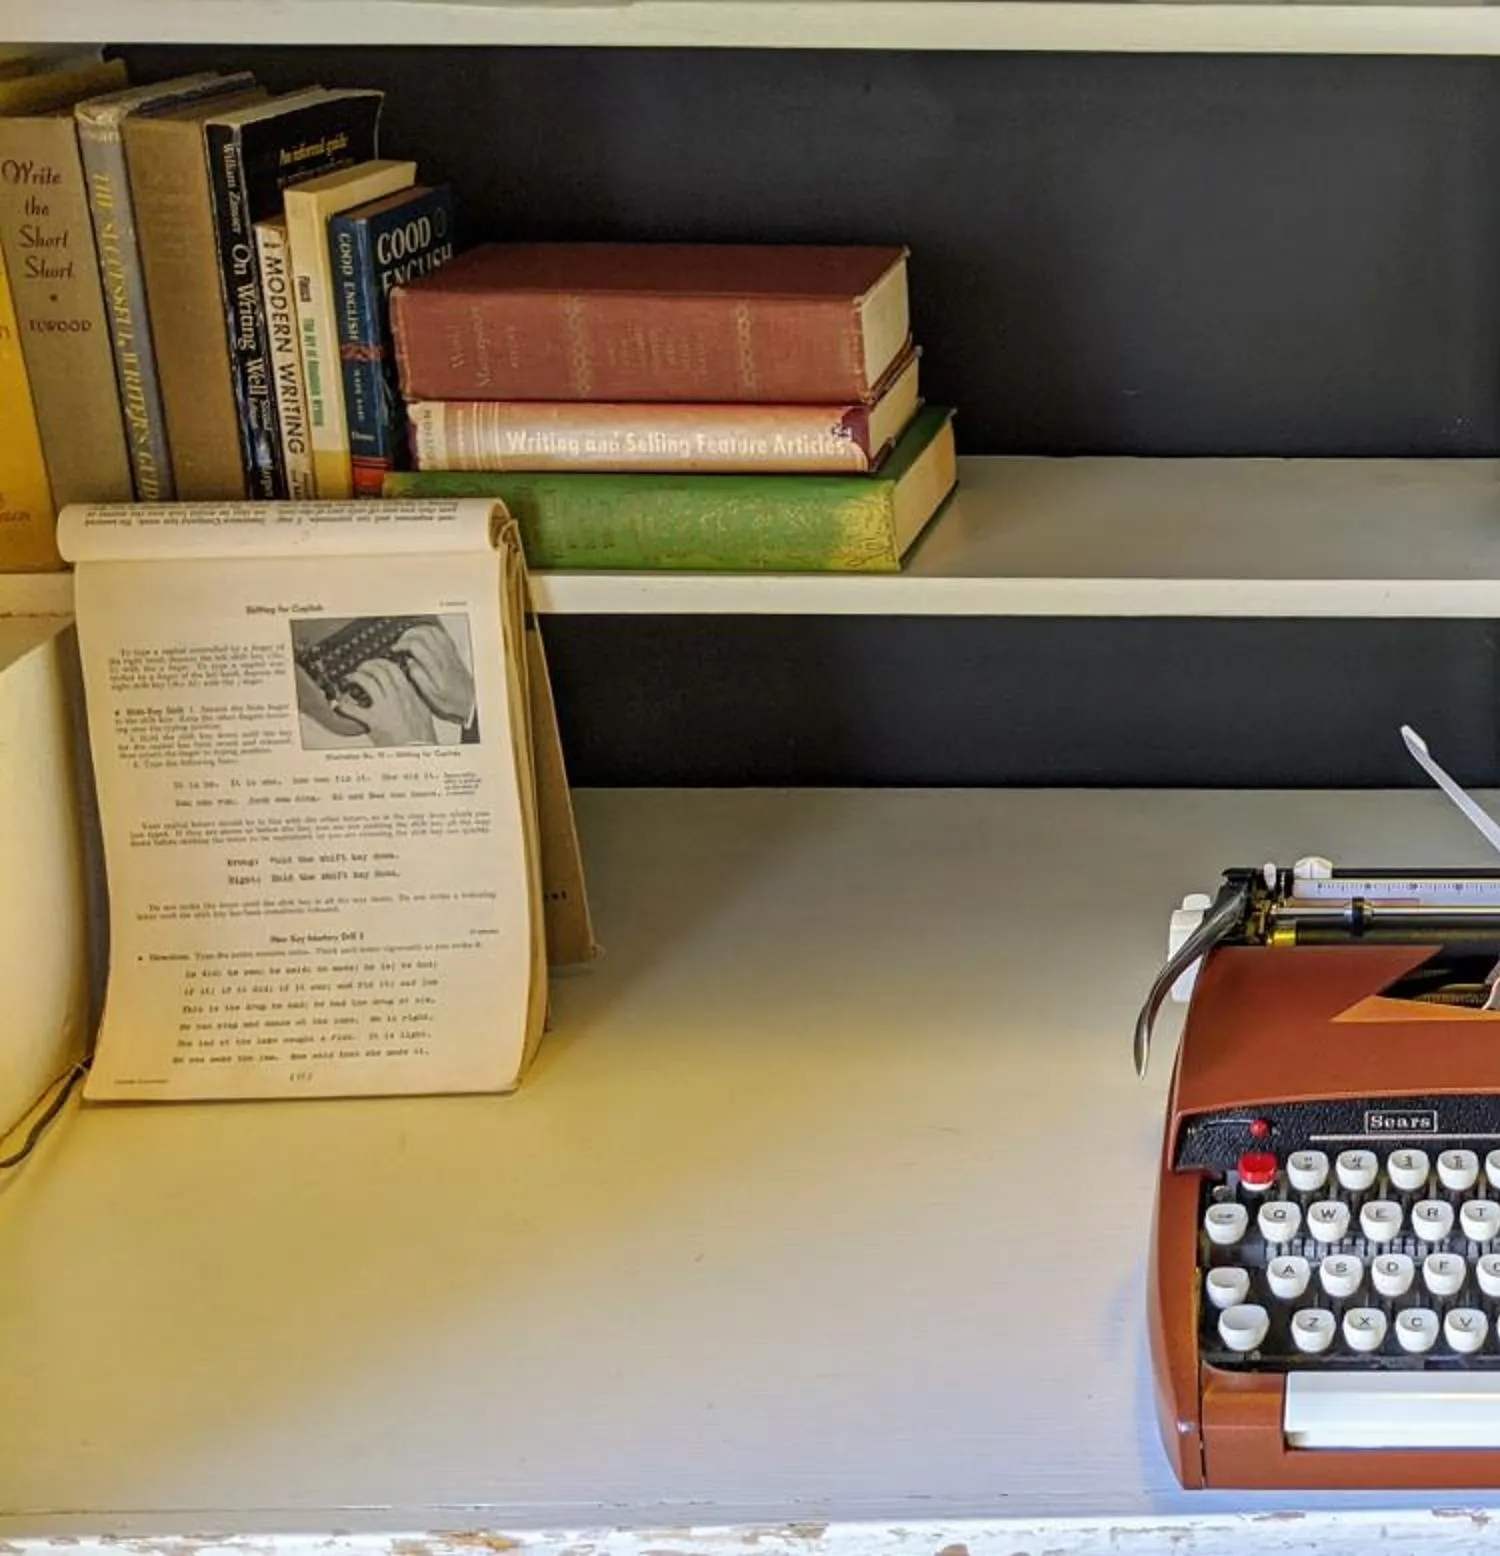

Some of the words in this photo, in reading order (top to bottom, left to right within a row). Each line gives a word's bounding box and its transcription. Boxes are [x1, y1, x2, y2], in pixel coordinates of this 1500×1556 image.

[2, 160, 62, 185] Write
[25, 196, 50, 217] the
[19, 224, 69, 249] Short
[377, 215, 431, 265] GOOD
[232, 243, 251, 276] On
[25, 255, 74, 279] Short
[264, 255, 294, 353] MODERN
[237, 284, 257, 351] Writing
[245, 357, 269, 401] Well
[277, 362, 305, 455] WRITING
[506, 431, 579, 457] Writing
[587, 432, 620, 454] and
[625, 432, 690, 458] Selling
[696, 433, 768, 456] Feature
[138, 451, 160, 500] GUID
[1371, 1113, 1432, 1129] Sears
[1273, 1209, 1286, 1219] Q
[1321, 1208, 1336, 1219] W
[1375, 1208, 1388, 1218] E
[1427, 1208, 1438, 1218] R
[1476, 1207, 1487, 1217] T
[1282, 1264, 1296, 1276] A
[1335, 1262, 1347, 1273] S
[1387, 1261, 1399, 1273] D
[1439, 1261, 1450, 1272] F
[1308, 1317, 1319, 1328] Z
[1360, 1316, 1371, 1327] X
[1411, 1317, 1423, 1327] C
[1460, 1316, 1472, 1328] V
